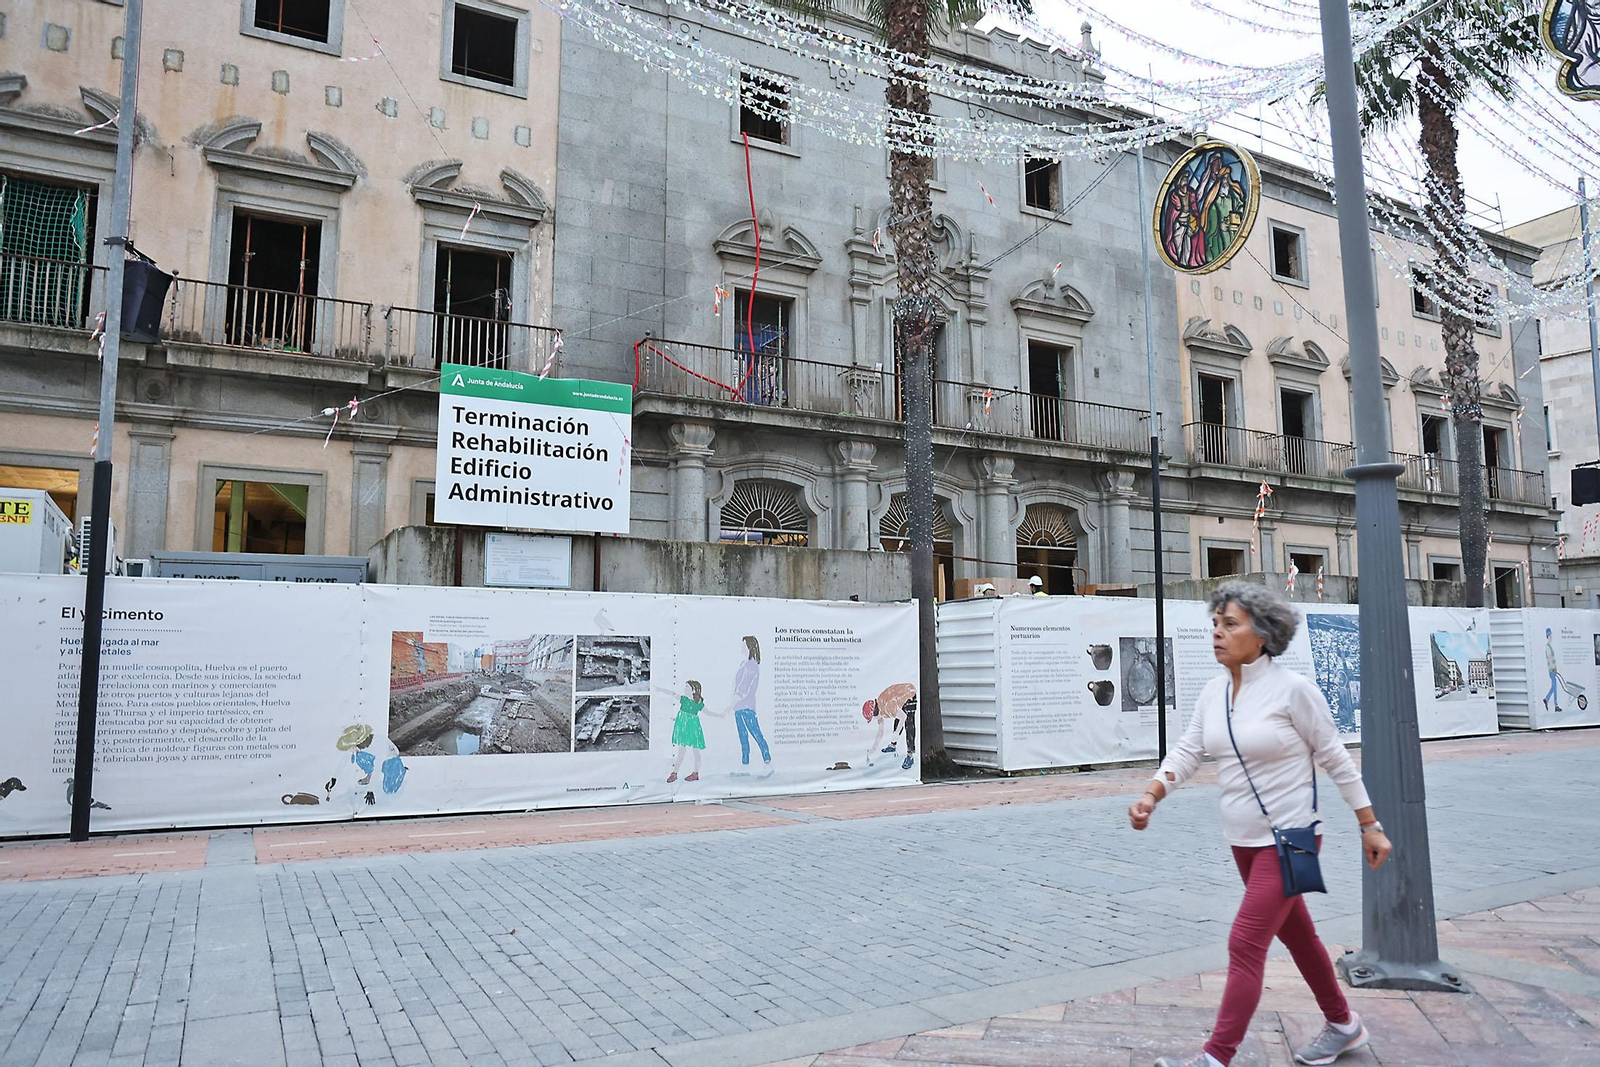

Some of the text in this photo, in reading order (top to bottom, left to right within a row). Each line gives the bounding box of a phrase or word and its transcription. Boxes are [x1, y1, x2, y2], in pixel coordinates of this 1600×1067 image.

[494, 380, 523, 389] Andalucía
[452, 405, 589, 436] Terminación
[452, 431, 608, 462] Rehabilitación
[451, 456, 532, 480] Edificio
[448, 482, 614, 510] Administrativo
[61, 607, 76, 618] El
[774, 635, 821, 644] planificación
[259, 663, 287, 672] puerto
[97, 727, 136, 737] primero
[254, 724, 275, 734] plata
